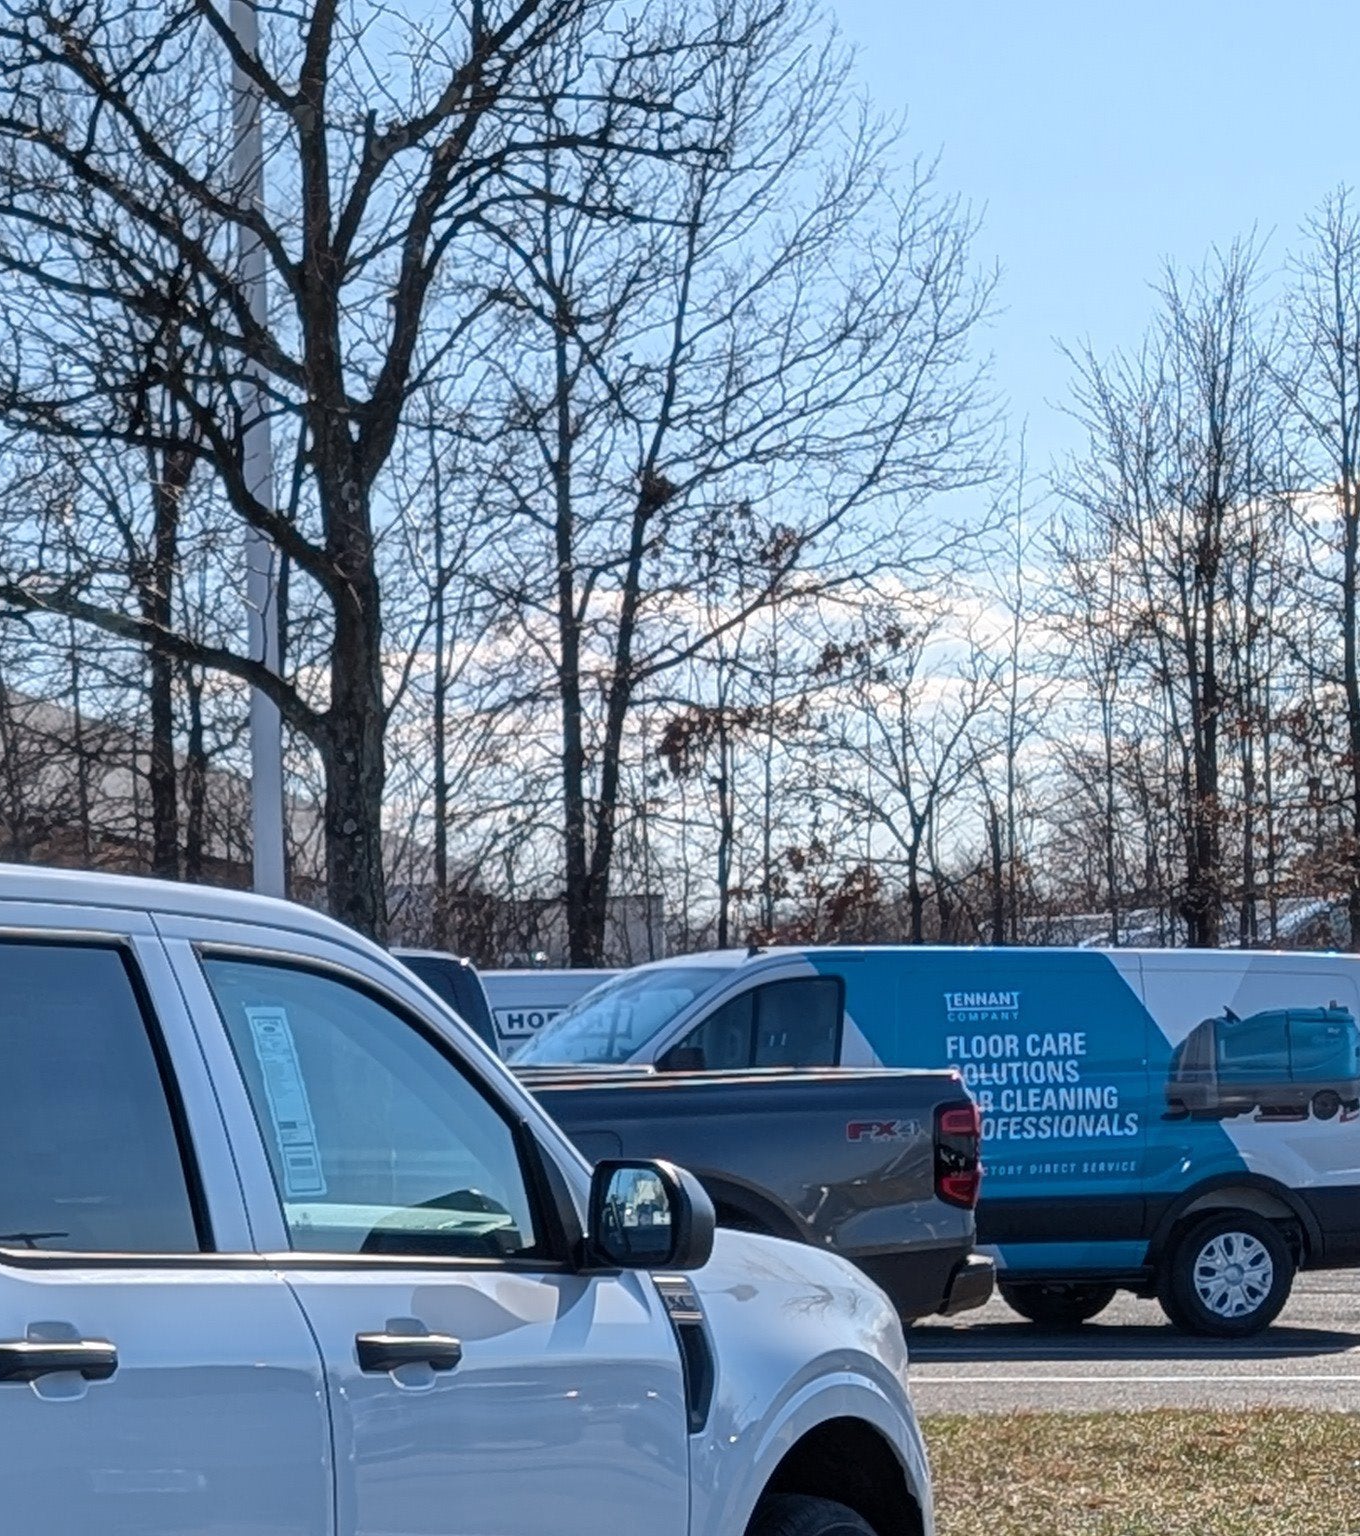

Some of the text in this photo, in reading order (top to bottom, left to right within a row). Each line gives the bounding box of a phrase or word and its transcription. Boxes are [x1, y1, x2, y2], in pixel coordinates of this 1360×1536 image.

[944, 991, 1019, 1011] TENNANT
[947, 1011, 1019, 1022] COMPANY
[946, 1032, 1087, 1059] FLOOR CARE
[951, 1060, 1080, 1086] OLUTIONS
[1001, 1086, 1119, 1113] CLEANING
[846, 1120, 920, 1142] FX4
[980, 1113, 1139, 1141] OFESSIONALS
[1030, 1162, 1077, 1175] DIRECT
[1082, 1160, 1137, 1174] SERVICE
